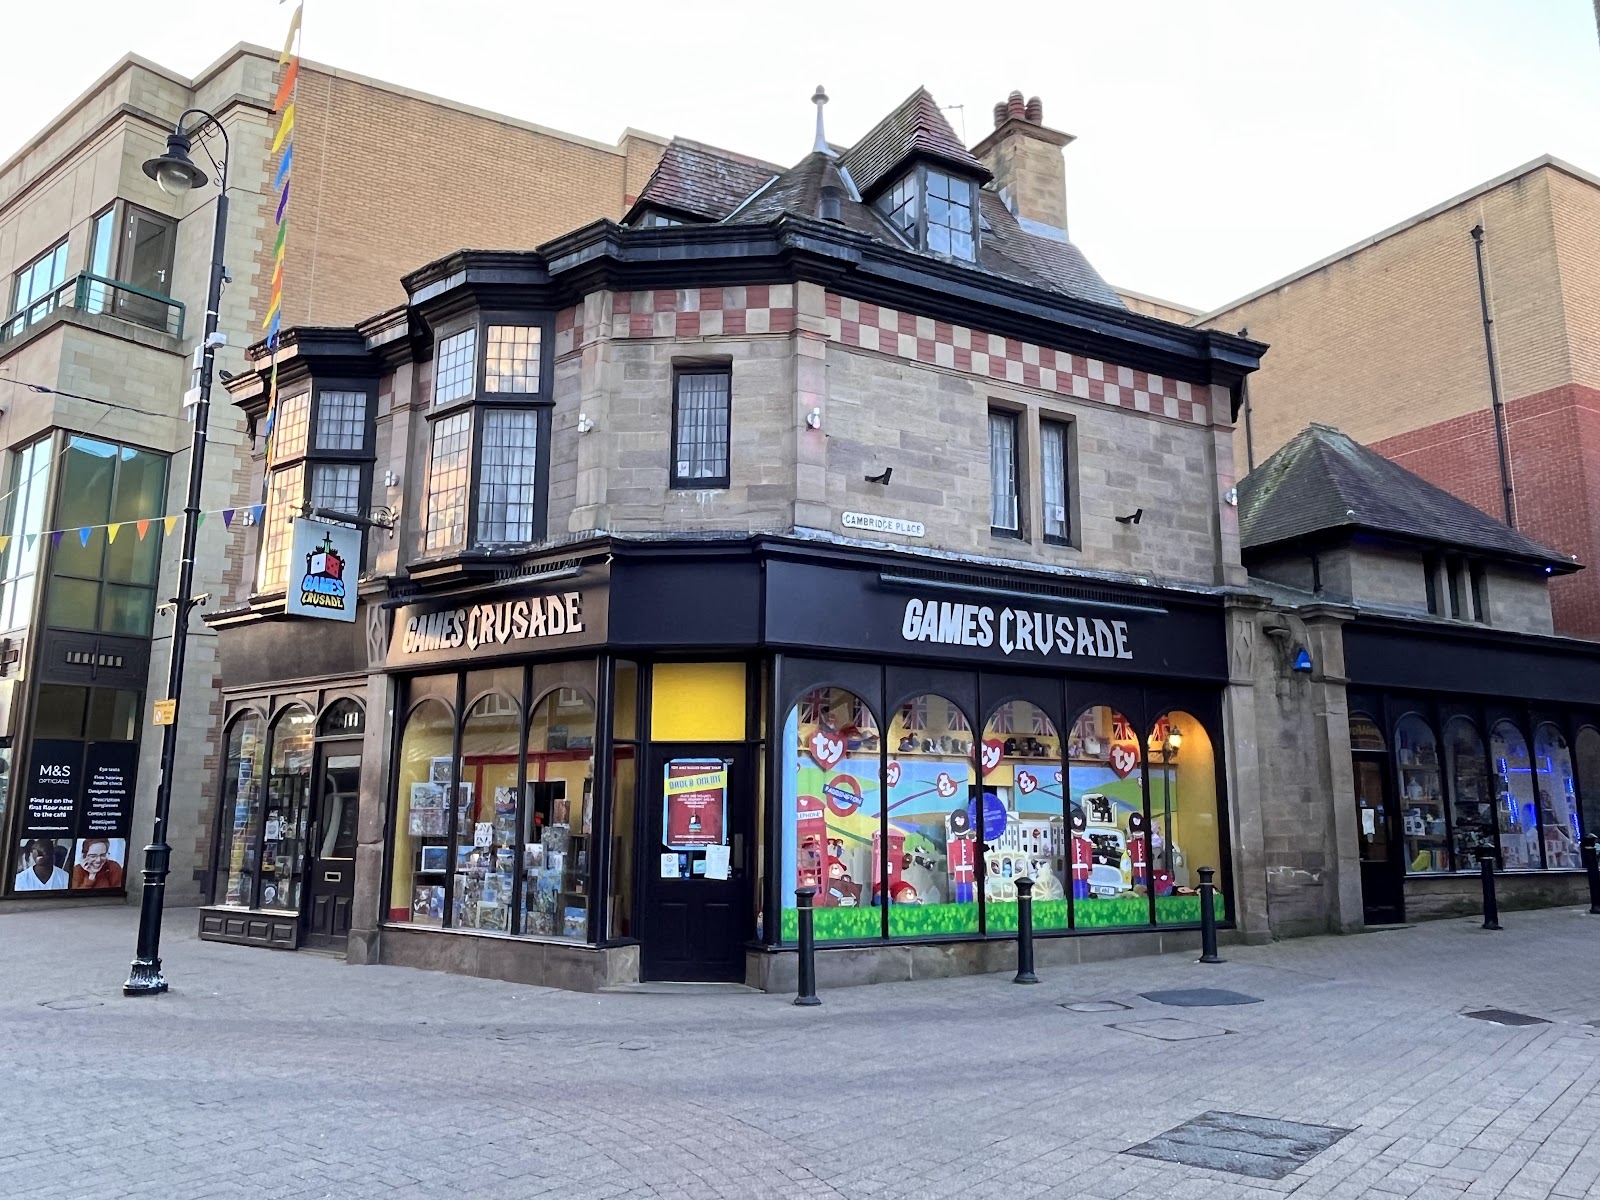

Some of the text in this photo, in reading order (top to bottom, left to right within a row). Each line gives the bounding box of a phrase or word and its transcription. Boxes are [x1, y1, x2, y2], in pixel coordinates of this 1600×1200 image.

[845, 514, 921, 534] CAMBRIDGE PLACE
[303, 575, 345, 597] GAMES
[301, 592, 344, 608] CRUSADE
[402, 591, 583, 654] GAMES CRUSADE
[902, 598, 1133, 660] GAMES CRUSADE
[39, 764, 71, 777] M&S
